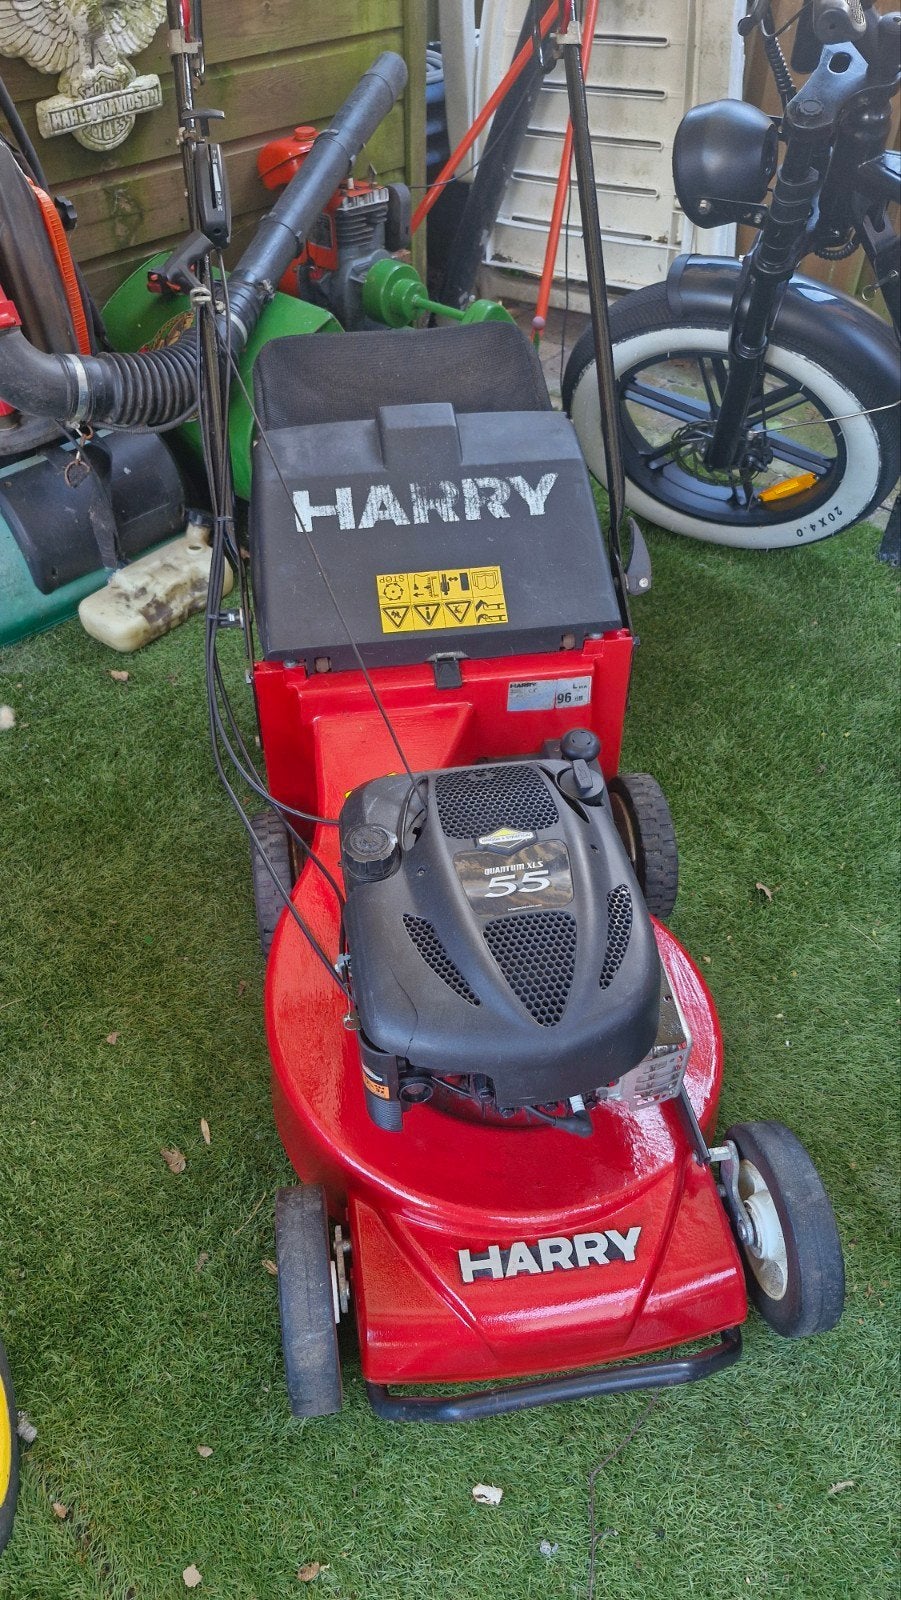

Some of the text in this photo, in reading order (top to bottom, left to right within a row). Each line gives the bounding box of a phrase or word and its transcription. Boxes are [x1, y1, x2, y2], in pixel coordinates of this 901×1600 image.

[292, 472, 559, 533] HARRY
[379, 574, 405, 584] STOP
[557, 692, 572, 704] 96
[484, 860, 544, 876] QUANTUM XLS
[484, 869, 551, 898] 55
[458, 1226, 642, 1283] HARRY
